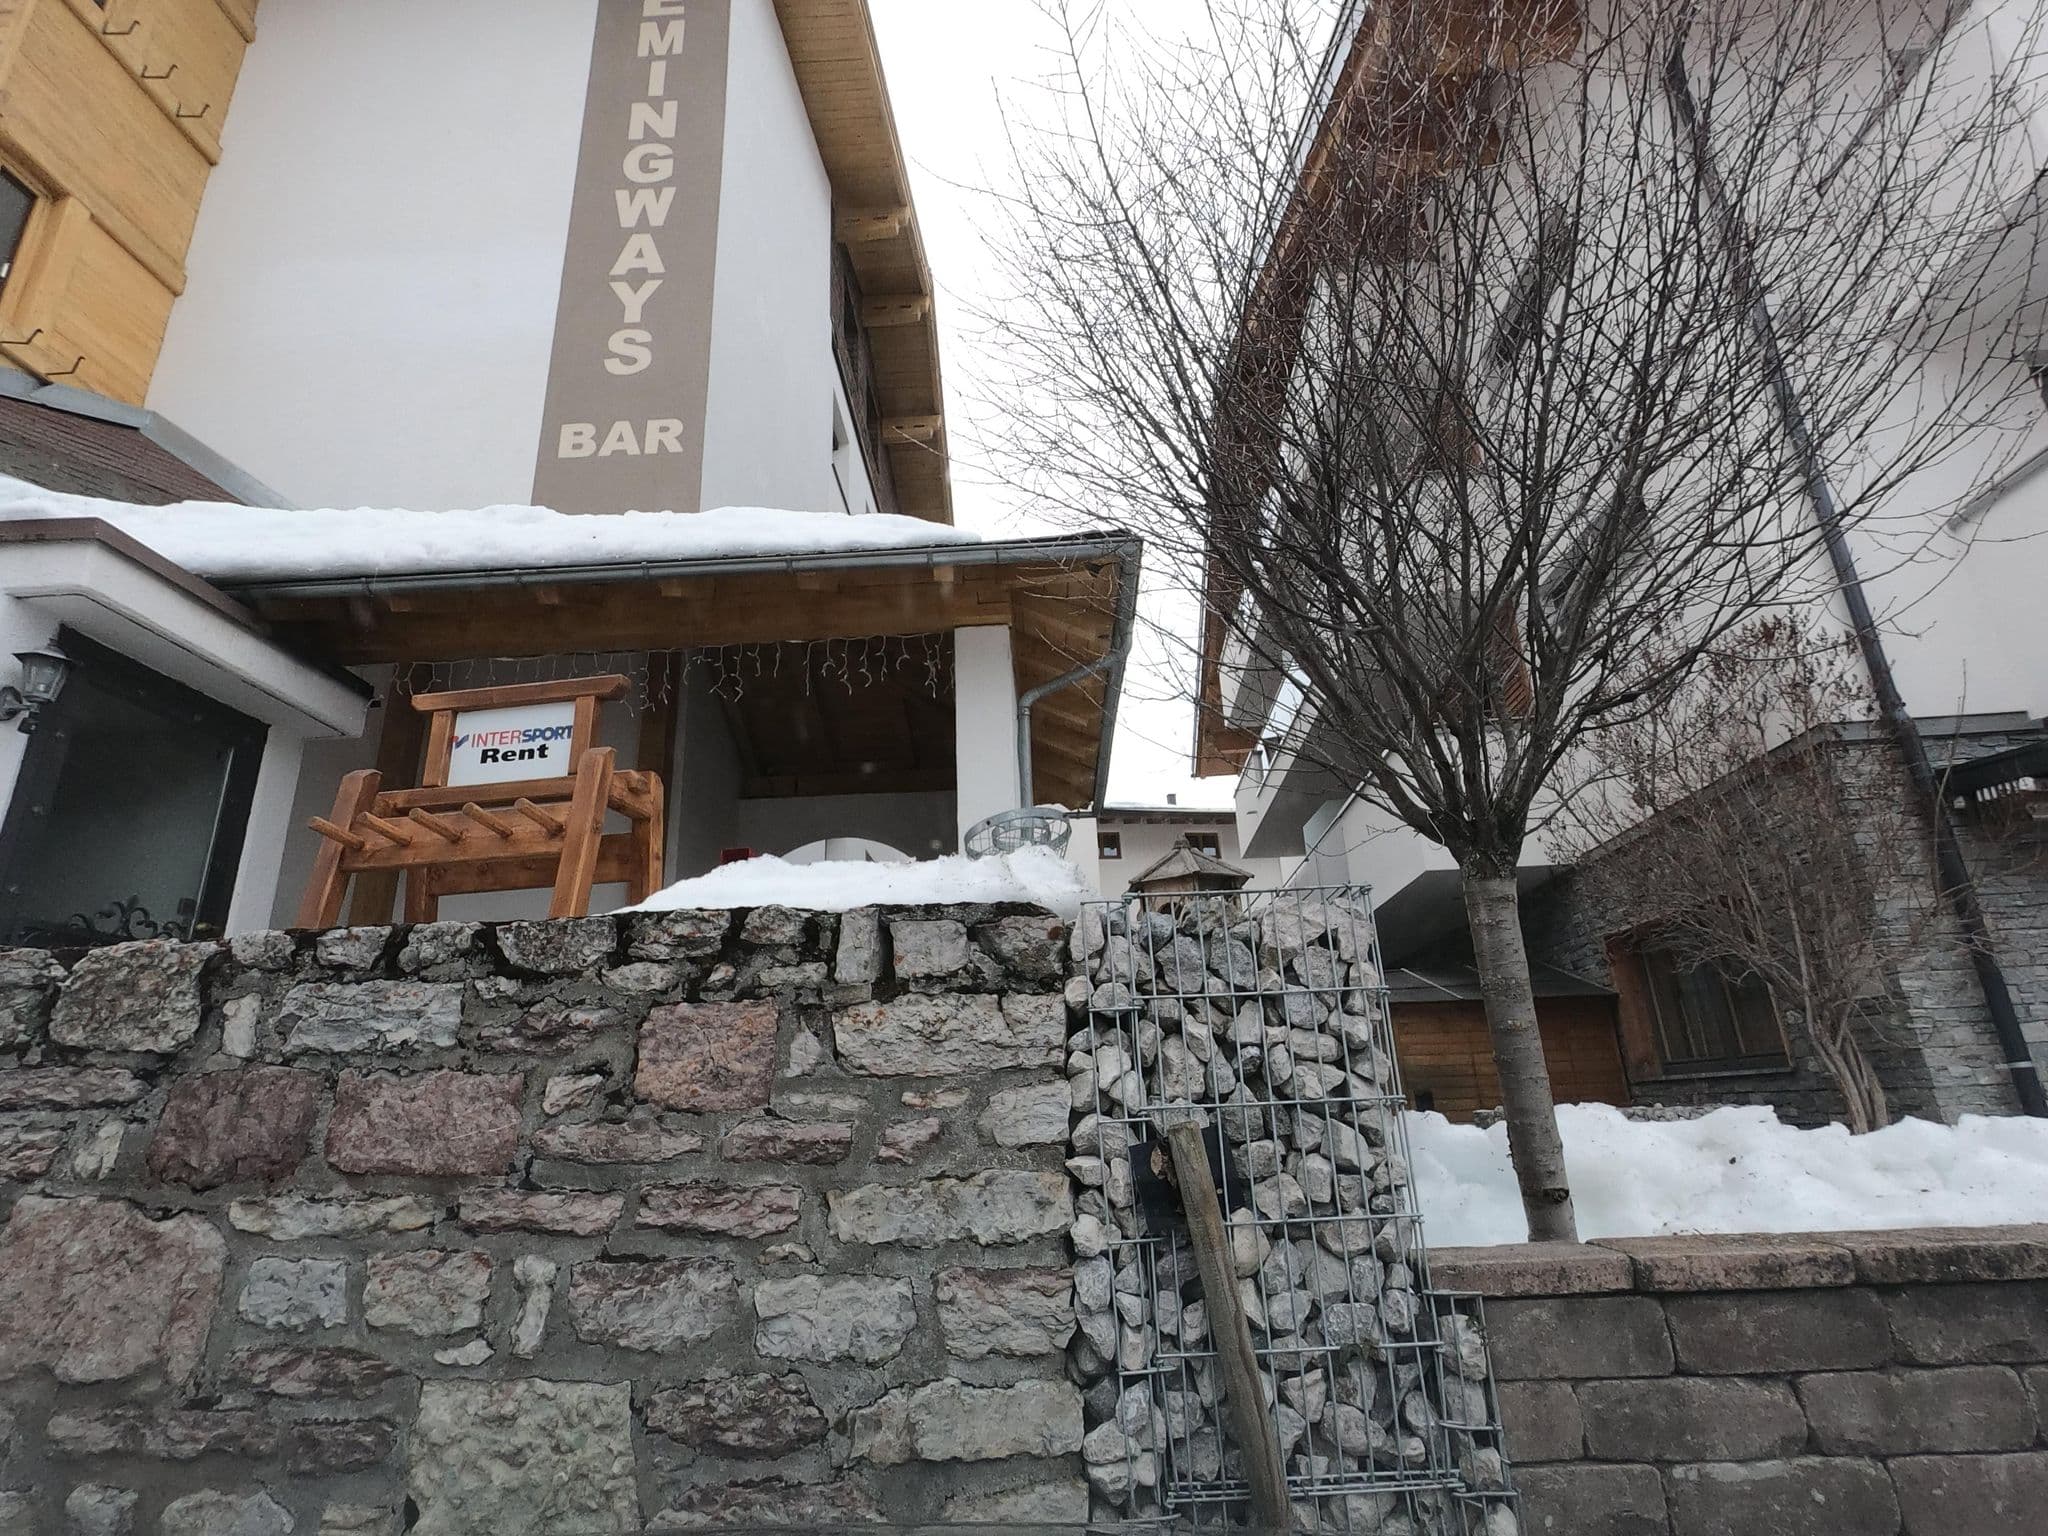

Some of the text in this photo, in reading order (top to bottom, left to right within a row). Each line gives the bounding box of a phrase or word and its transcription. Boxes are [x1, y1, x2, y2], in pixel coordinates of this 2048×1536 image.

[557, 418, 684, 458] BAR
[471, 725, 574, 748] INTERSPORT
[480, 743, 549, 764] Rent
